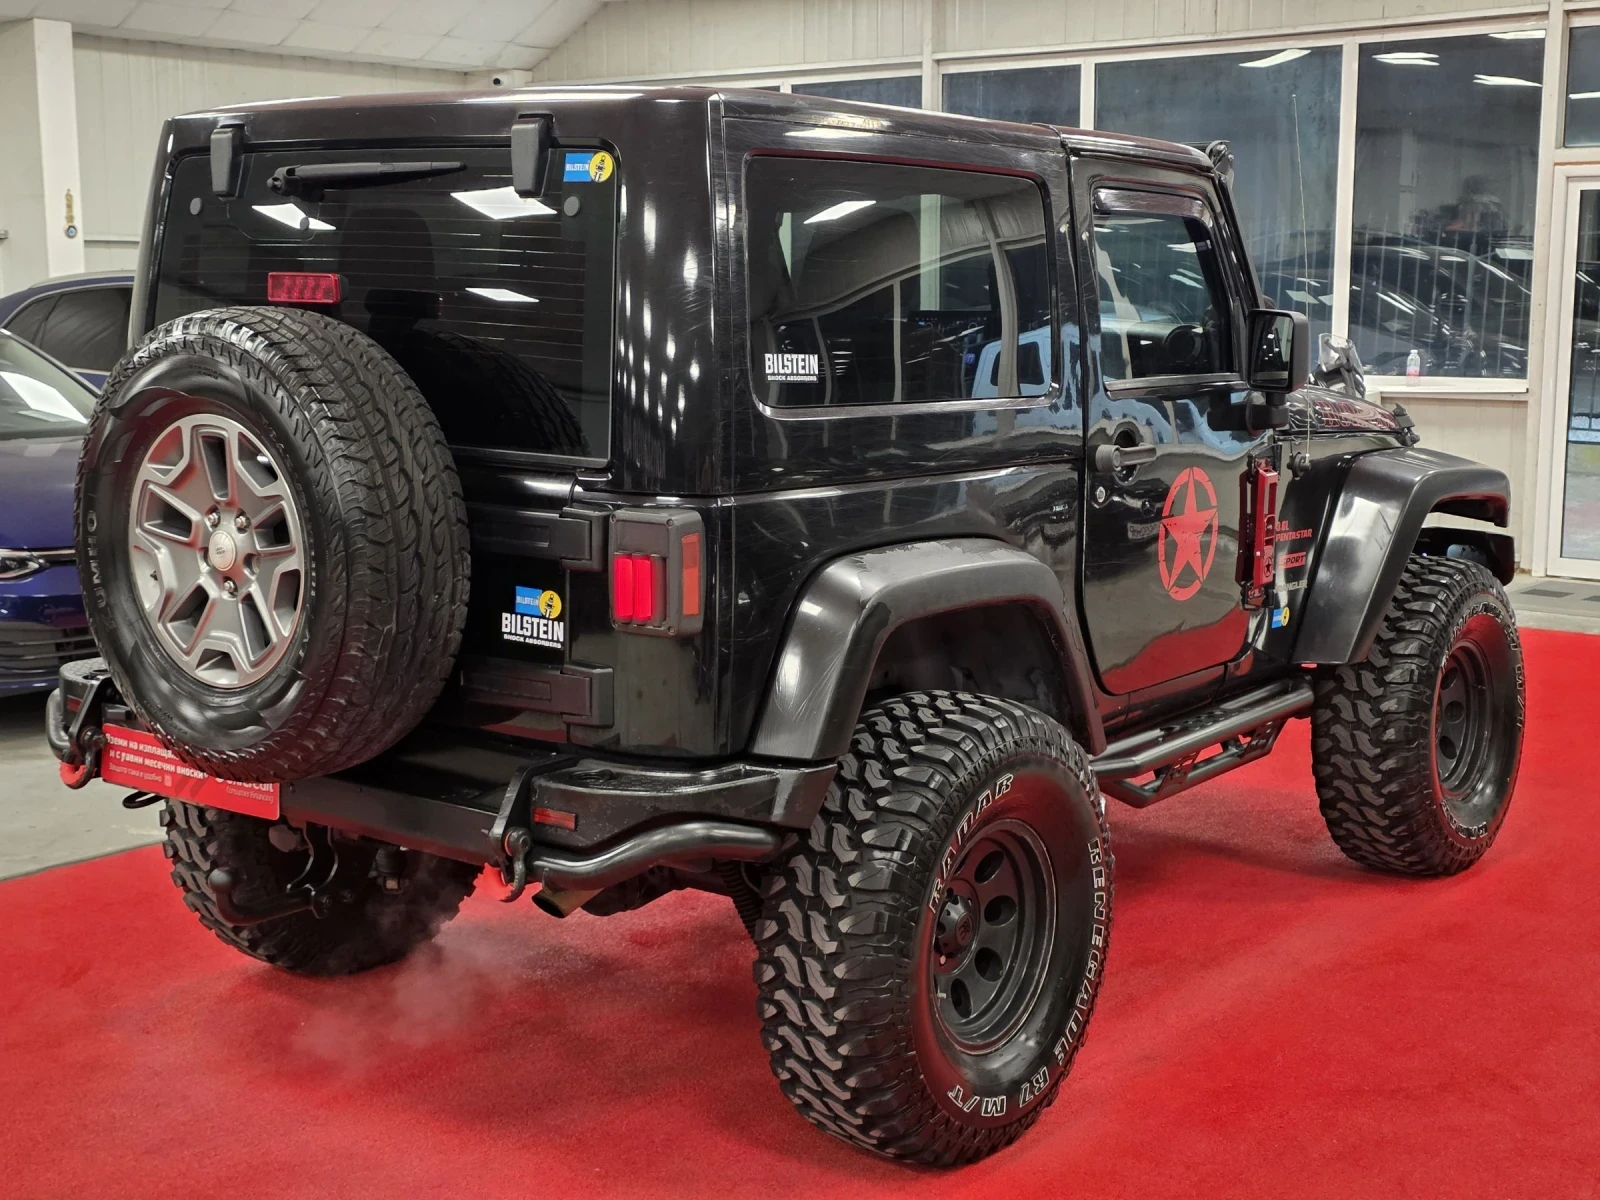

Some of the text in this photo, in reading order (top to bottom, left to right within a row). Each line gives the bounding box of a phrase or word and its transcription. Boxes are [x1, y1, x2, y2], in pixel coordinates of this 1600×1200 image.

[765, 353, 818, 374] BILSTEIN
[1276, 528, 1313, 542] PENTASTAR
[515, 595, 540, 606] BILSTEIN
[501, 612, 564, 642] BILSTEIN
[503, 633, 562, 649] SHOCK ABSORBERS
[128, 740, 138, 750] на
[138, 743, 180, 760] изплаща
[121, 752, 143, 765] равни
[144, 757, 175, 772] месечни
[226, 785, 249, 797] Consumer
[929, 773, 1014, 914] RADAR
[1052, 836, 1106, 1066] RENEGADE
[946, 1084, 1007, 1117] M/T
